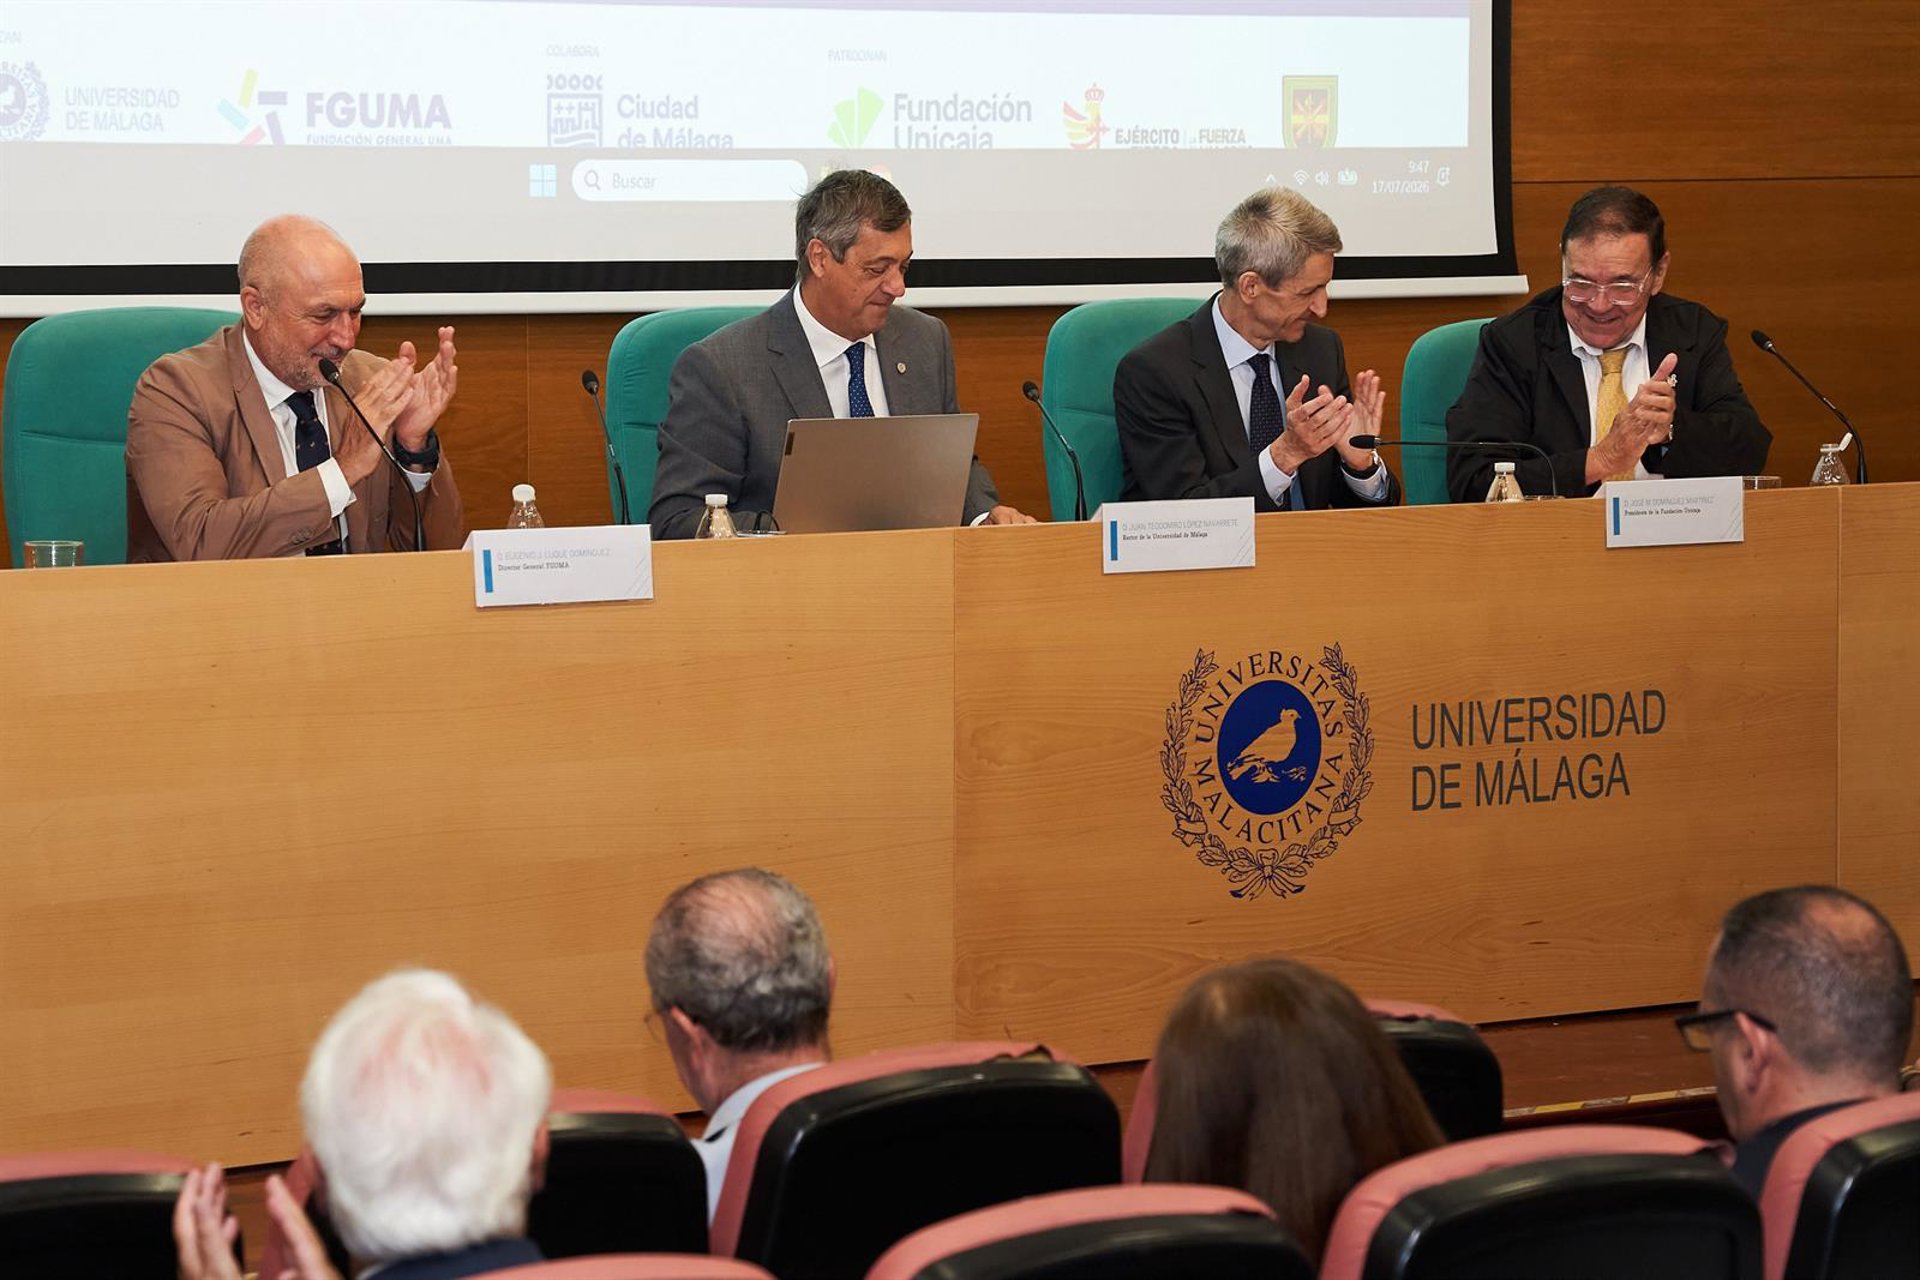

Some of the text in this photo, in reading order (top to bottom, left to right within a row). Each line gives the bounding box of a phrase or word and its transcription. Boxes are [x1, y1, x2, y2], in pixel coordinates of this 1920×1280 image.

[546, 45, 600, 57] COLABORA
[828, 49, 887, 62] PATROCINAN
[65, 86, 181, 109] UNIVERSIDAD
[617, 94, 699, 119] Ciudad
[894, 93, 1032, 122] Fundación
[66, 109, 164, 132] DE MÁLAGA
[306, 92, 452, 129] FGUMA
[376, 135, 424, 145] GENERAL
[428, 136, 452, 145] UMA
[617, 126, 734, 148] de Málaga
[894, 125, 993, 148] Unicaja
[1115, 125, 1180, 144] EJÉRCITO
[1199, 128, 1246, 144] FUERZA
[612, 173, 656, 190] Buscar
[1372, 180, 1430, 194] 17/07/2026
[1152, 532, 1182, 540] Universidad
[1195, 651, 1344, 744] UNIVERSITAS
[1412, 690, 1666, 750] UNIVERSIDAD
[1412, 748, 1630, 811] DE MÁLAGA
[1189, 753, 1344, 843] MALACITANA
